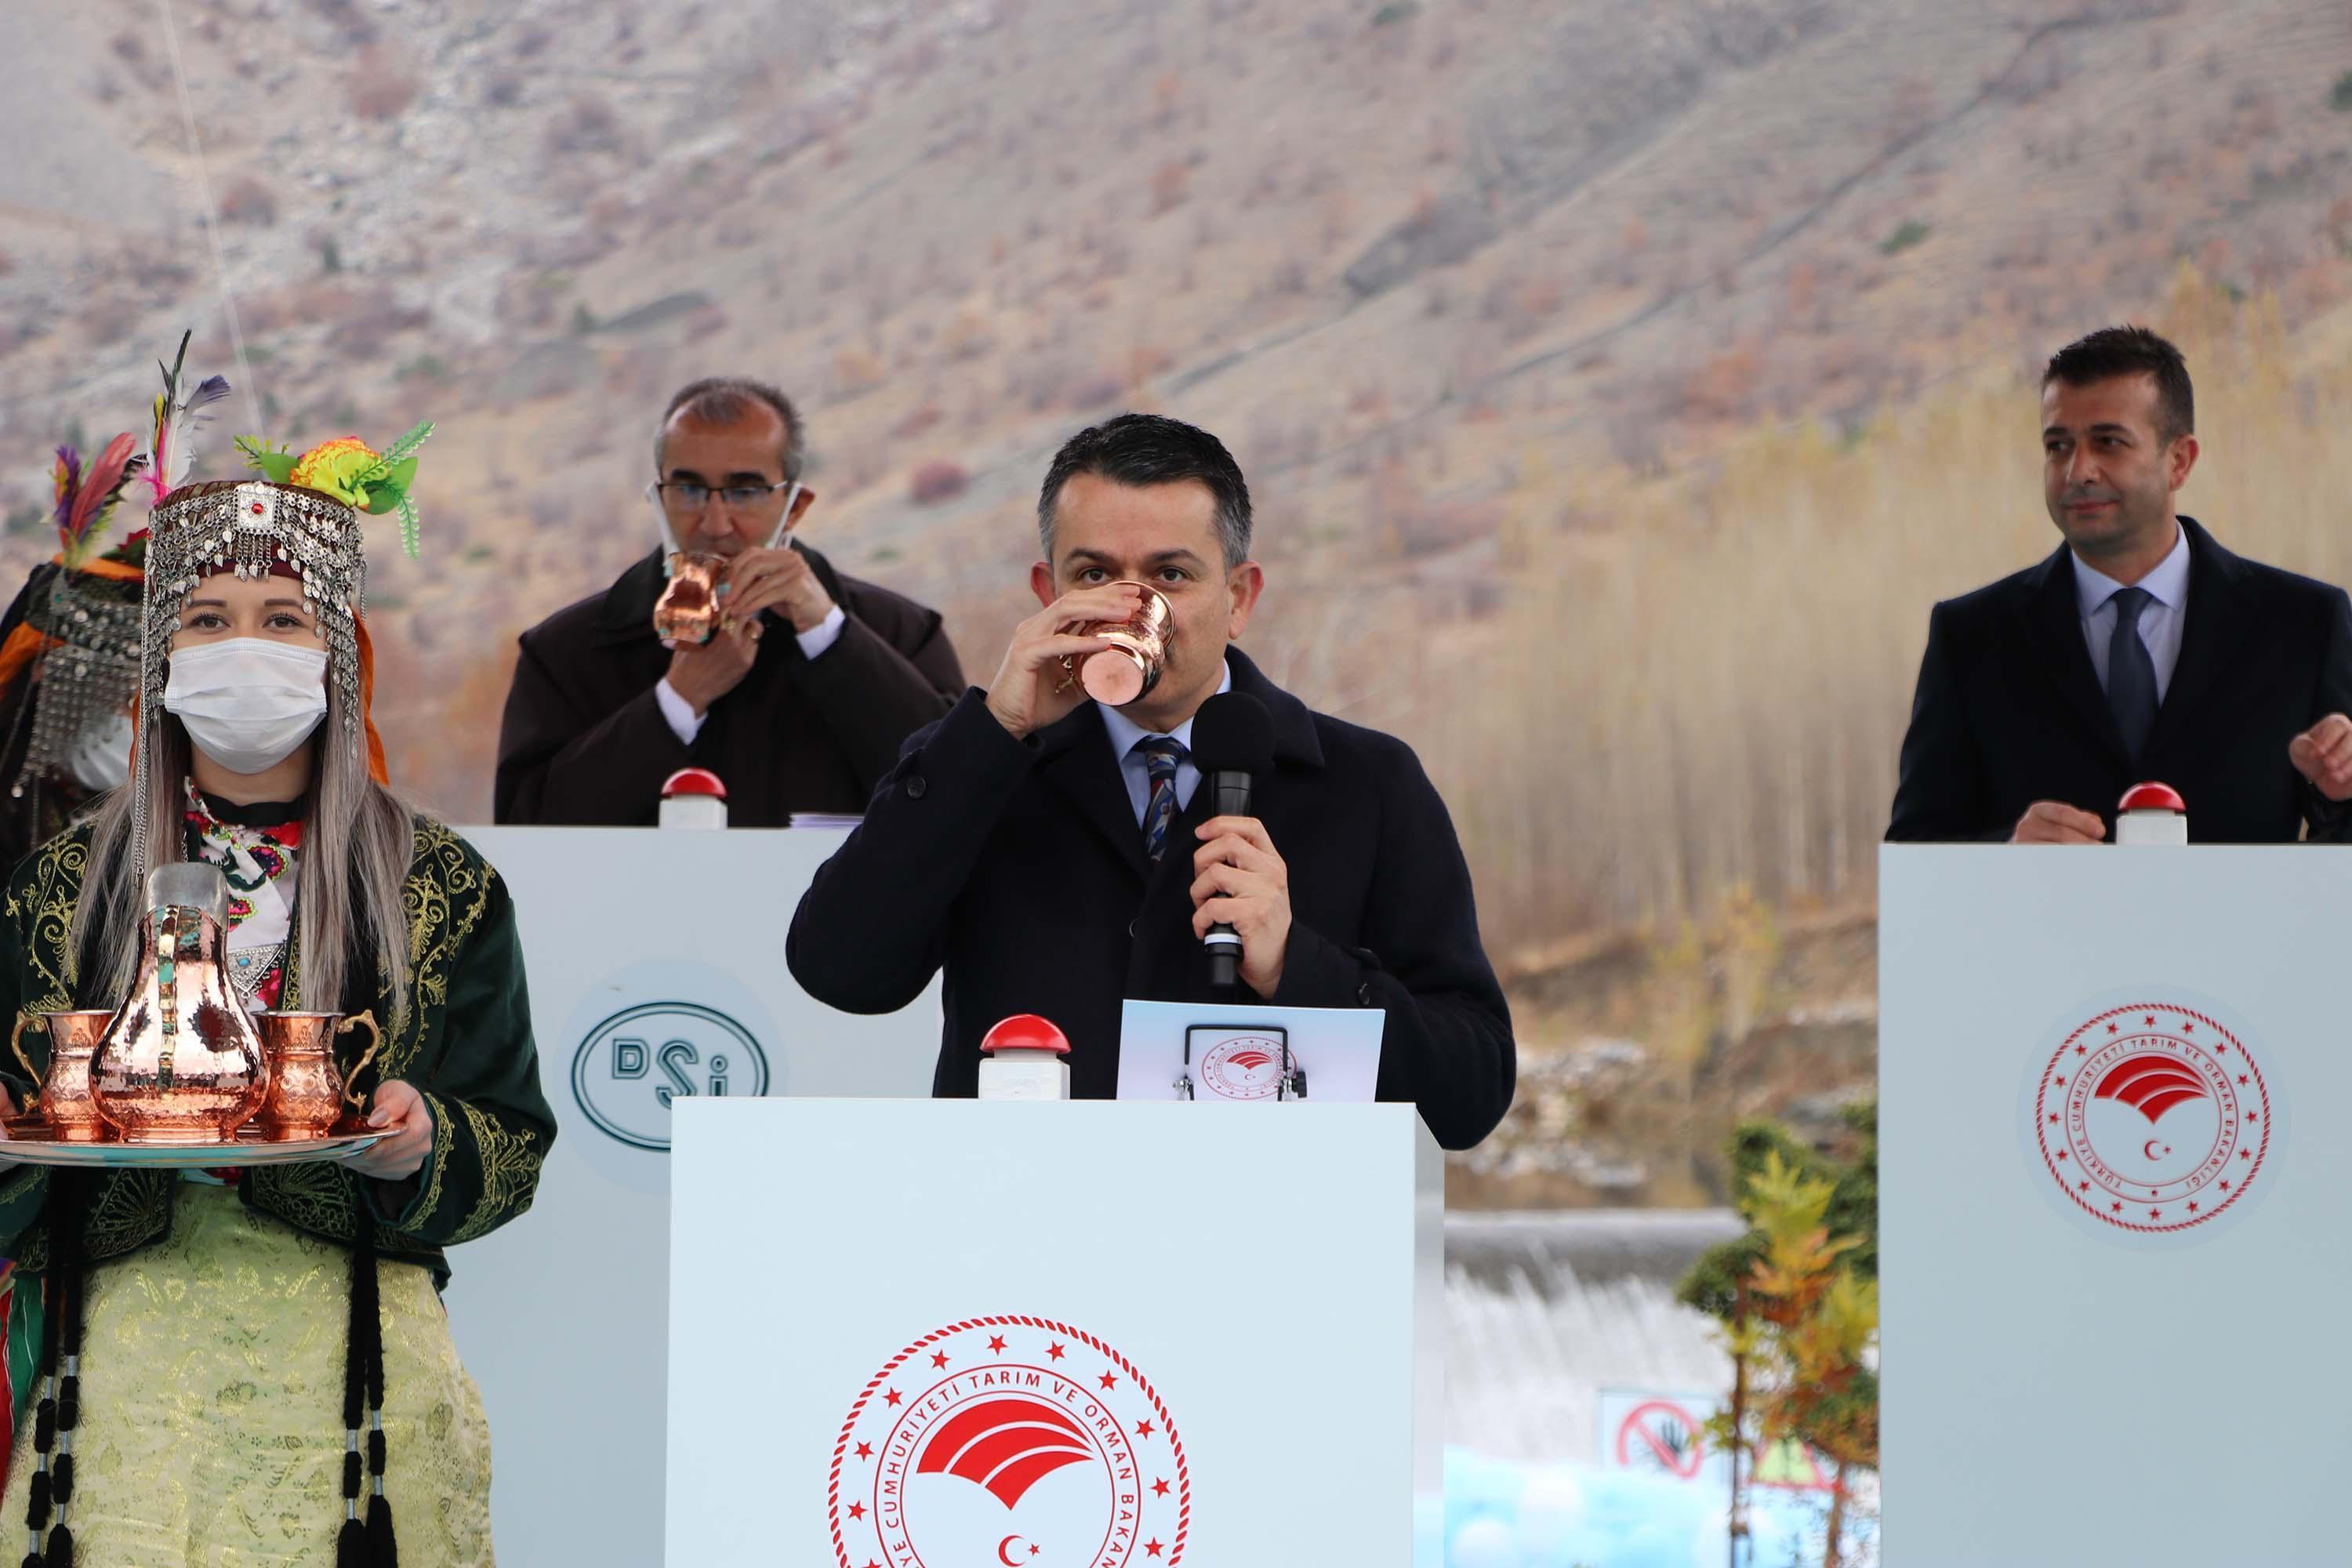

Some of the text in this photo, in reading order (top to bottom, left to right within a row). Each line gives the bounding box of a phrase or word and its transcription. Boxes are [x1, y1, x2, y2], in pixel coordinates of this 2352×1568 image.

[2131, 1037, 2177, 1049] TARIM
[2184, 1046, 2201, 1061] VE
[2204, 1062, 2234, 1112] ORMAN
[884, 1381, 961, 1529] CUMHURİYETİ
[968, 1370, 1041, 1388] TARIM
[1053, 1380, 1079, 1403] VE
[1084, 1403, 1133, 1480] ORMAN
